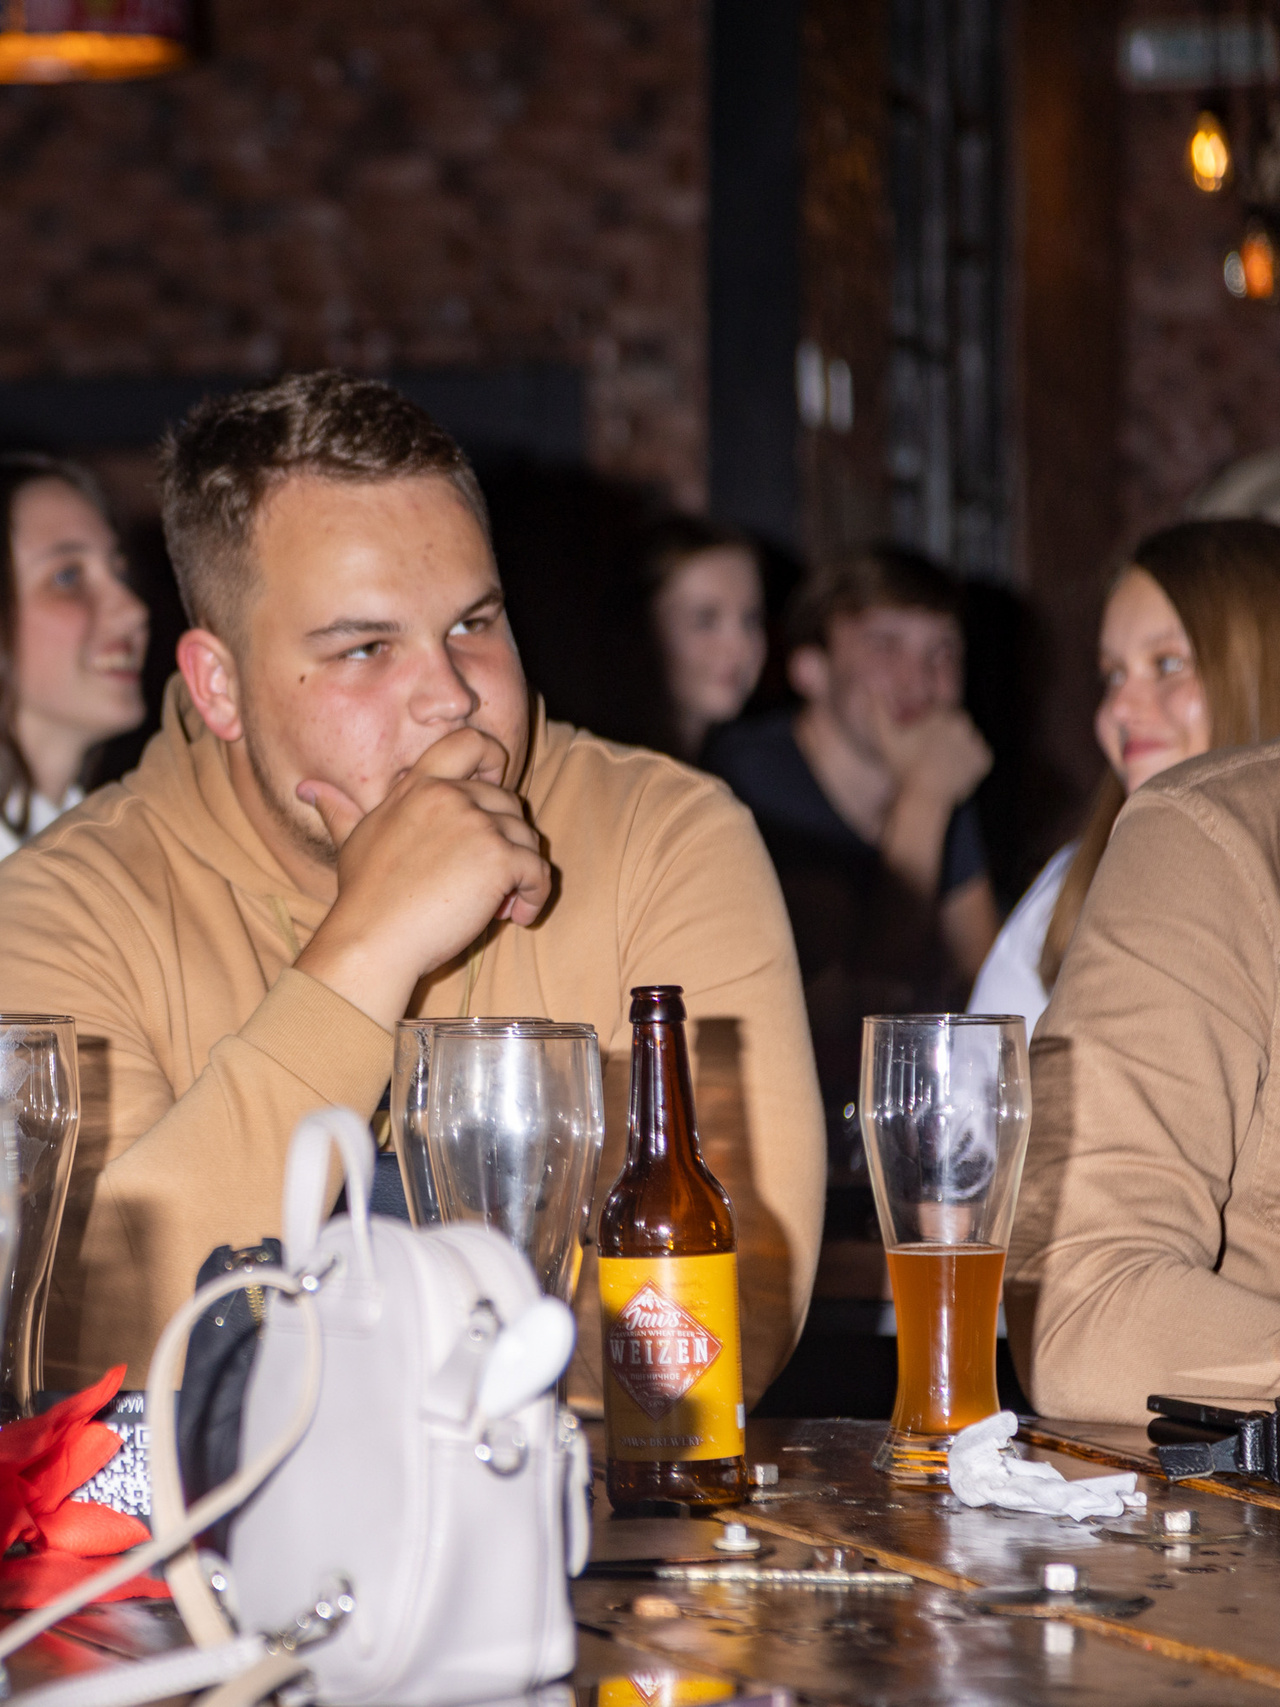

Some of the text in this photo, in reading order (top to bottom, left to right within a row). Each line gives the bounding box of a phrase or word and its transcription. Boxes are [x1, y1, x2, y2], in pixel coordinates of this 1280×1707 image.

[625, 1307, 681, 1330] Jaws
[677, 1330, 695, 1338] BEER
[609, 1338, 708, 1364] WEIZEN
